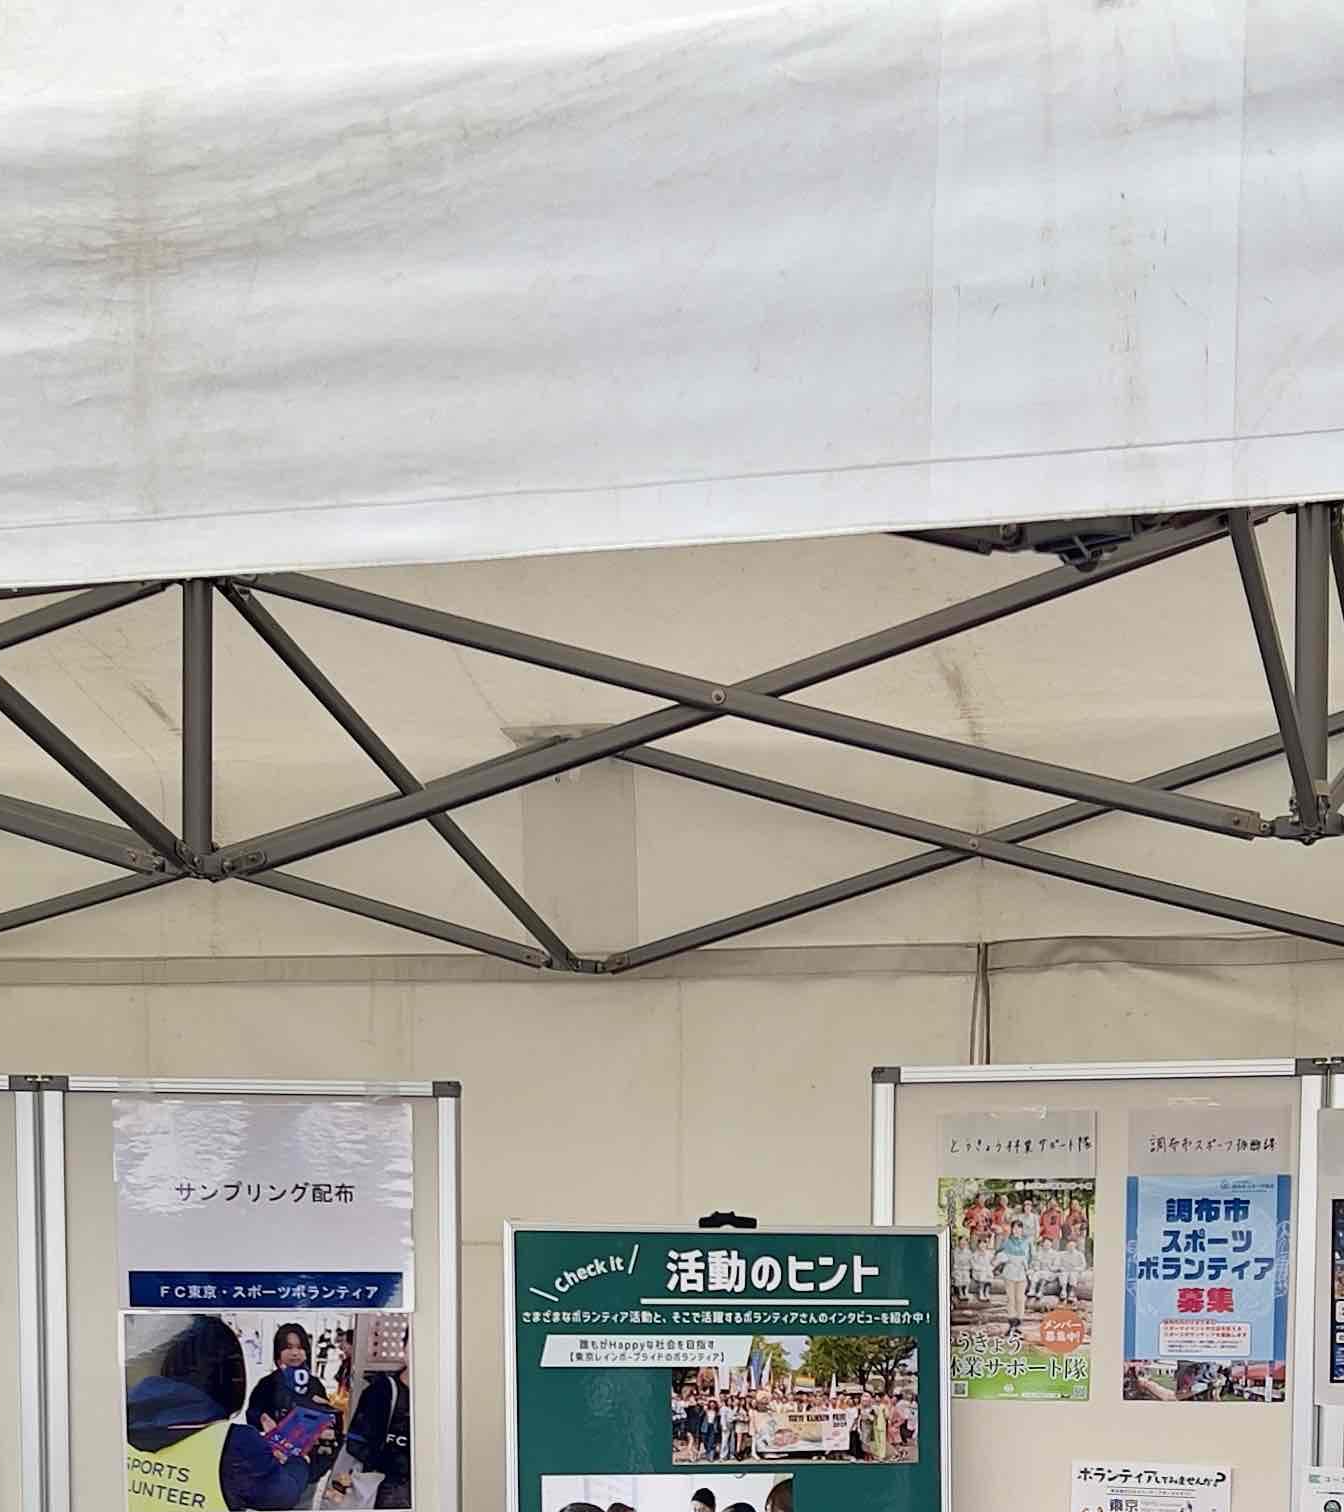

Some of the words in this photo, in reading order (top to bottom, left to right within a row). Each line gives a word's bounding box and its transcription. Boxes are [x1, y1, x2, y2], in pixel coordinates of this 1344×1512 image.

[175, 1181, 356, 1204] サンプリング配布
[1166, 1197, 1250, 1222] 調布市
[1161, 1228, 1252, 1253] スポーツ
[554, 1259, 607, 1293] check
[609, 1255, 625, 1272] it
[665, 1248, 881, 1294] 活動のヒント
[1137, 1256, 1274, 1280] ボランティア
[1177, 1287, 1234, 1313] 募集
[957, 1330, 1025, 1354] うきょう
[1077, 1467, 1227, 1488] ボランティアしてみませんか？
[129, 1480, 207, 1509] UNTEER
